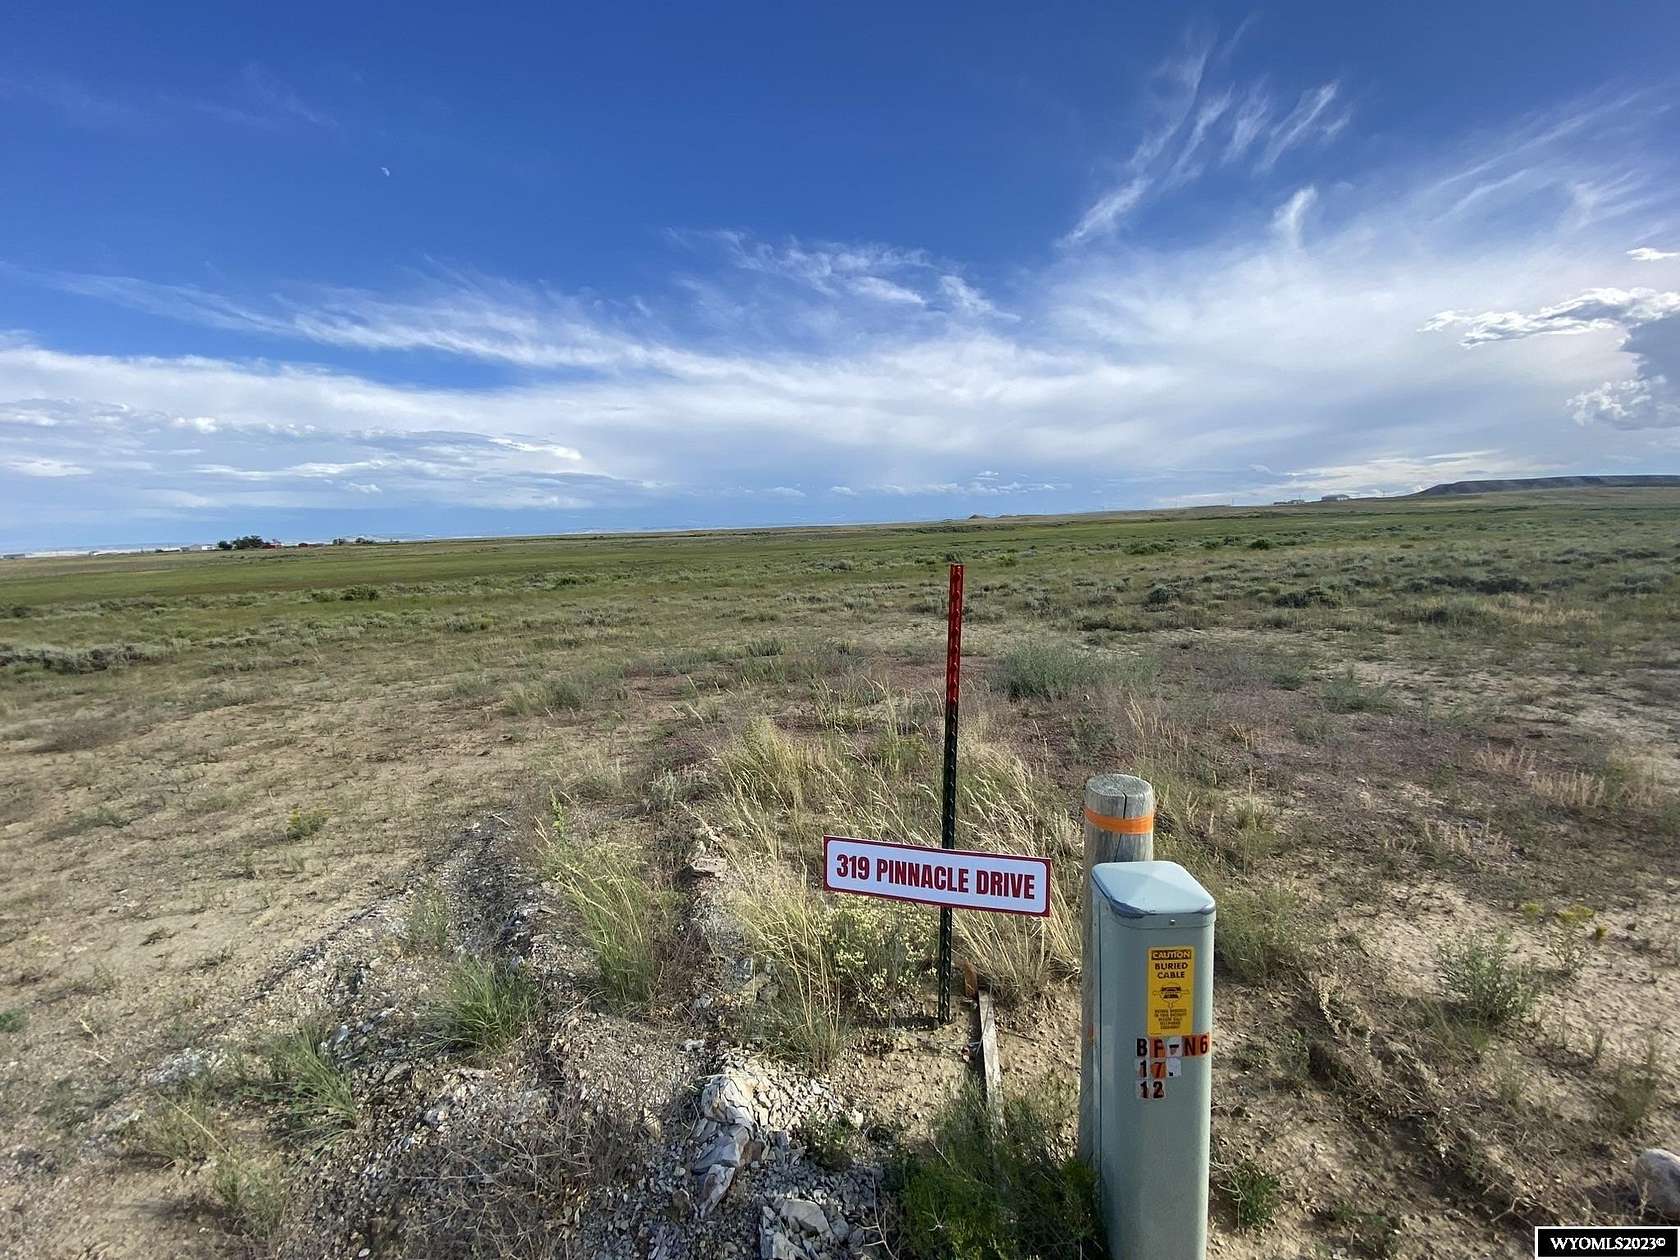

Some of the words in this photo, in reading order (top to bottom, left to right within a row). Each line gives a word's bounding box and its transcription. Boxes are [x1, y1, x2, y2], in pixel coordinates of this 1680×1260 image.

[836, 854, 870, 880] 319
[876, 858, 969, 893] PINNACLE
[976, 870, 1035, 900] DRIVE
[1152, 950, 1191, 959] CAUTION
[1154, 962, 1188, 970] BURIED
[1157, 971, 1185, 979] CABLE
[1140, 1081, 1165, 1099] 12
